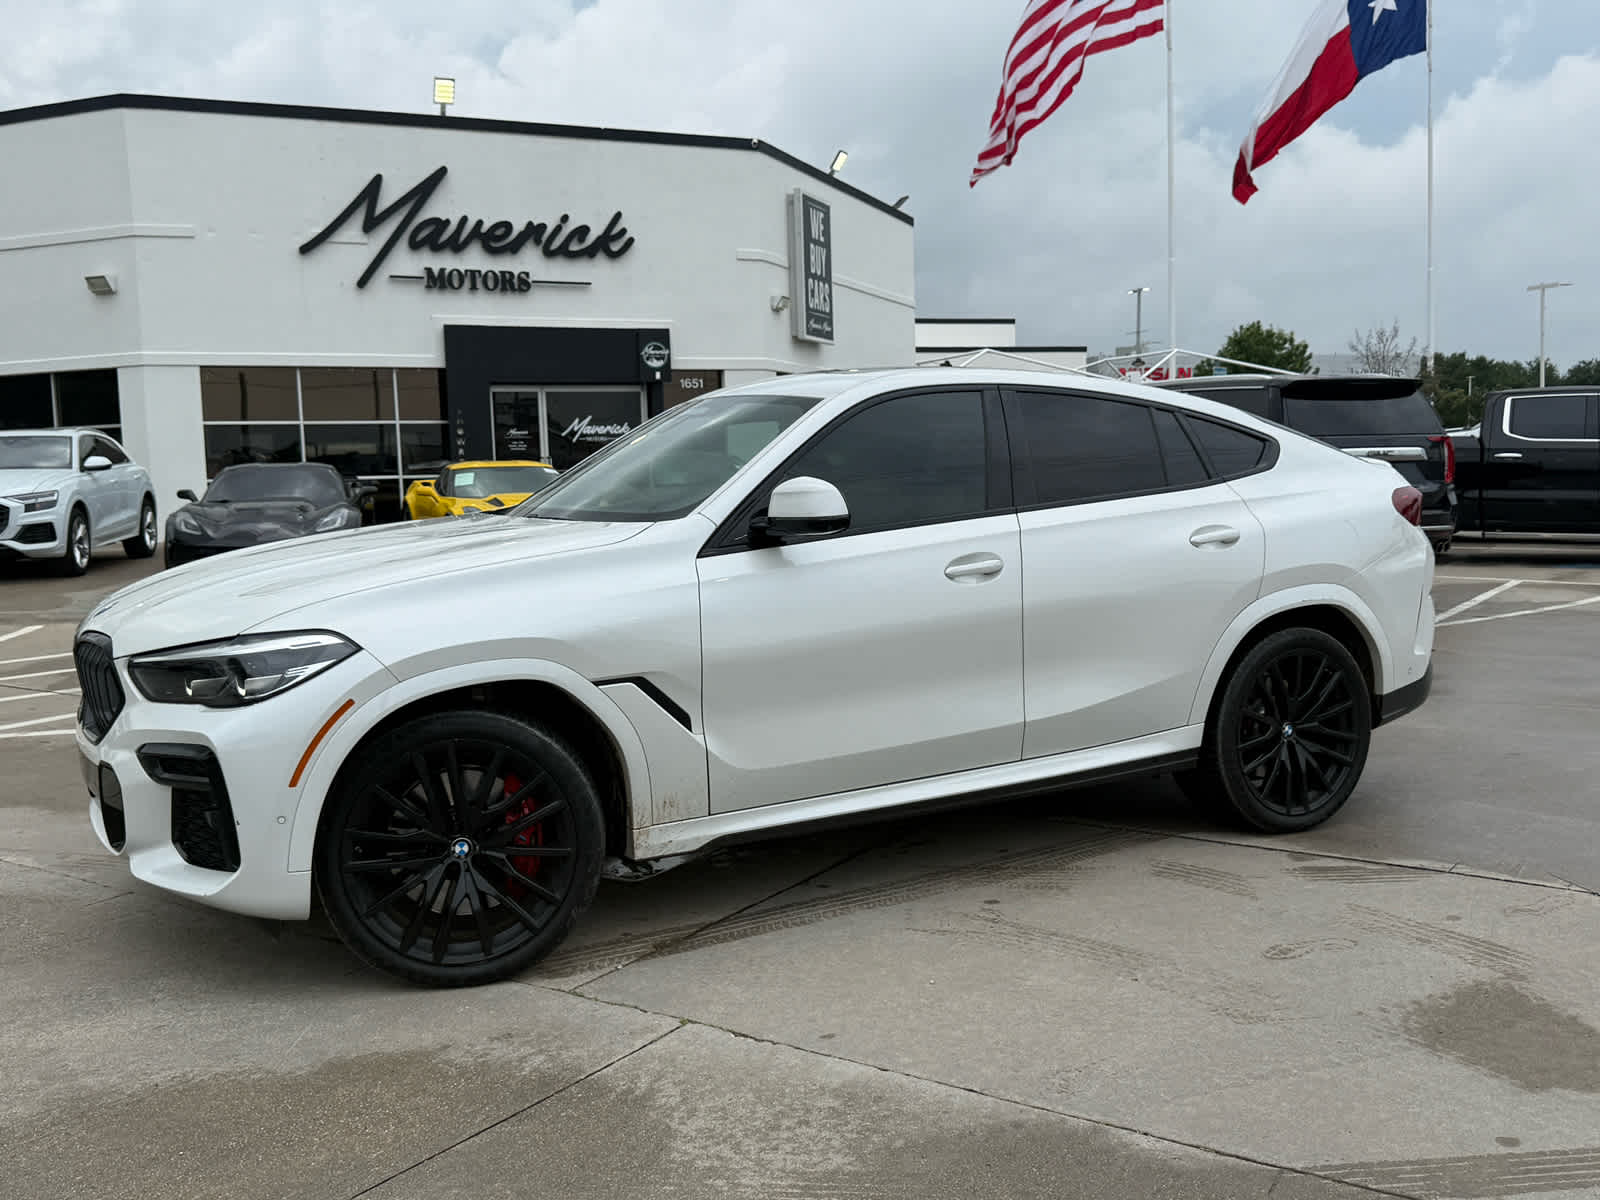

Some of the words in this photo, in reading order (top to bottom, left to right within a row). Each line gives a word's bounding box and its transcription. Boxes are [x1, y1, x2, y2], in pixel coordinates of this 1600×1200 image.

[299, 165, 635, 289] Maverick
[809, 207, 825, 242] WE
[809, 243, 826, 278] BUY
[424, 267, 532, 293] MOTORS
[808, 278, 830, 313] CARS
[679, 375, 704, 389] 1651
[560, 415, 631, 443] Maverick
